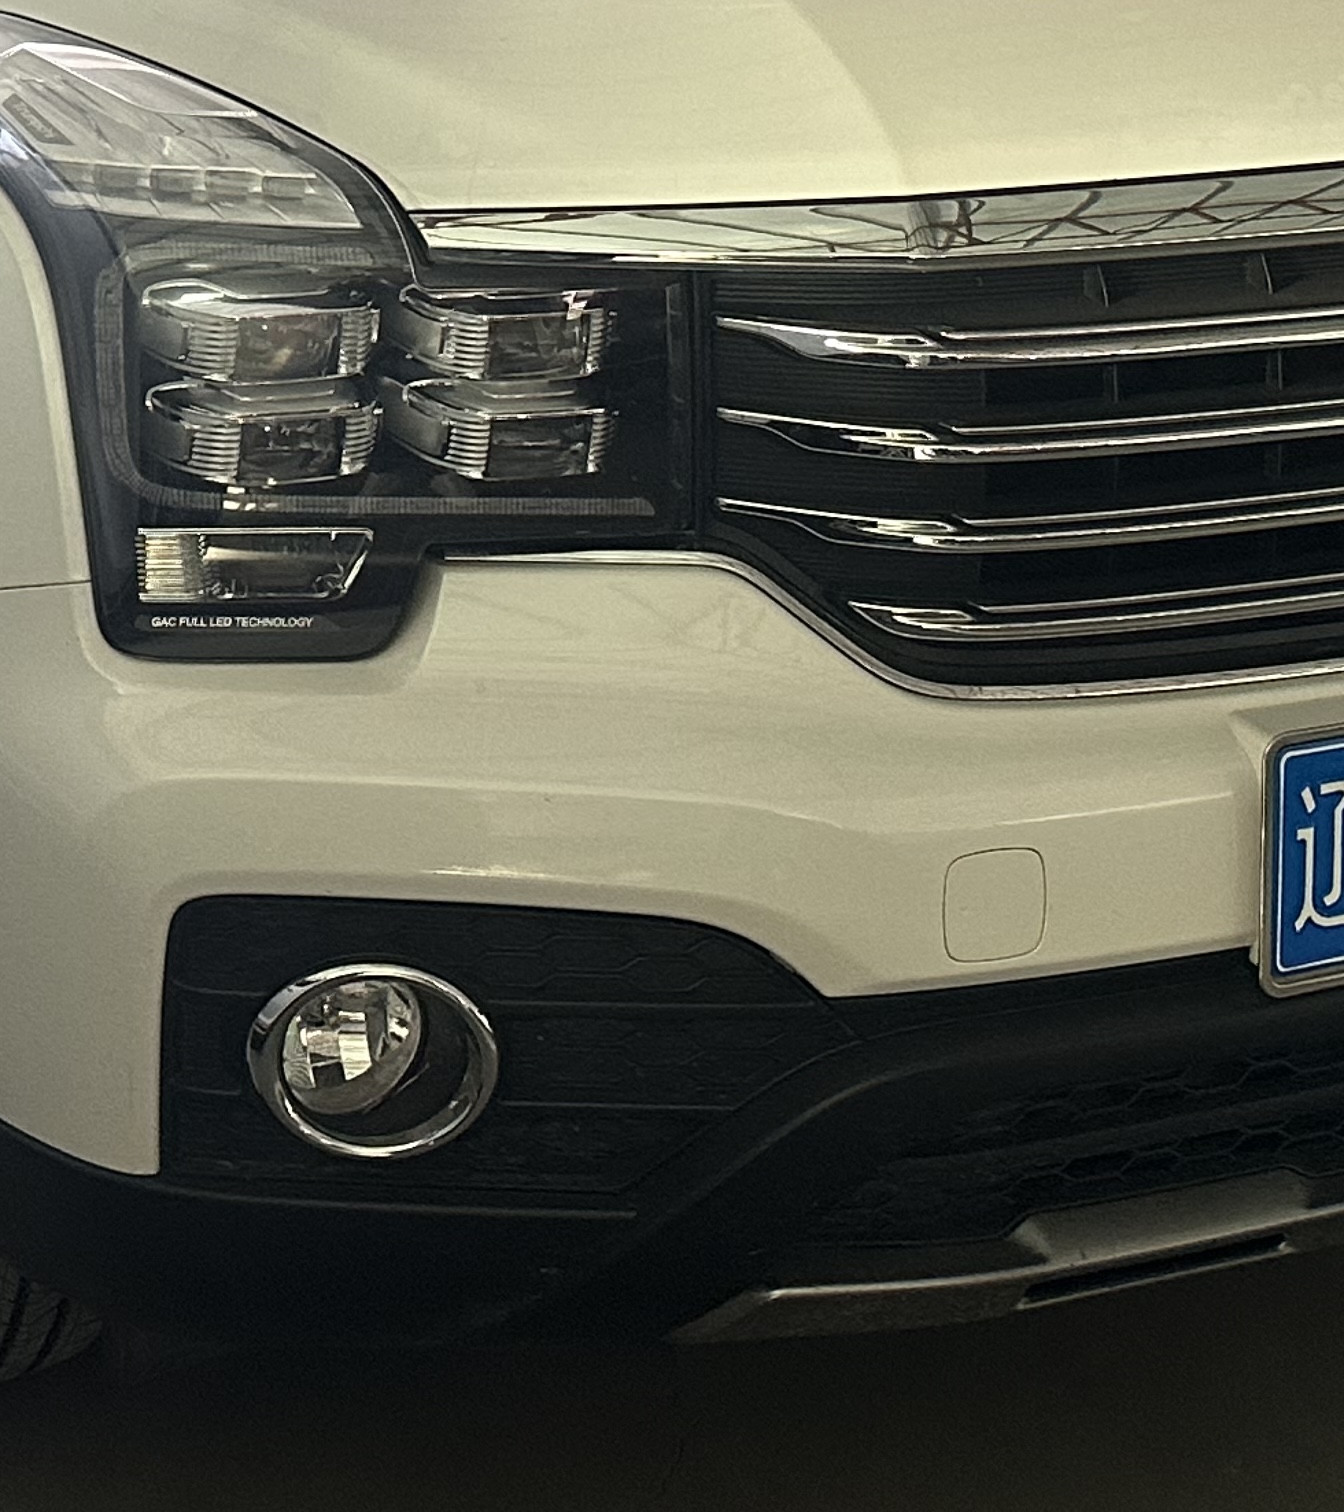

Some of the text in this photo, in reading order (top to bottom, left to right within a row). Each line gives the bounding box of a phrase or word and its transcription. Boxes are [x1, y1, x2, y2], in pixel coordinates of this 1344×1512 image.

[151, 616, 314, 628] GAC FULL LED TECHNOLOGY
